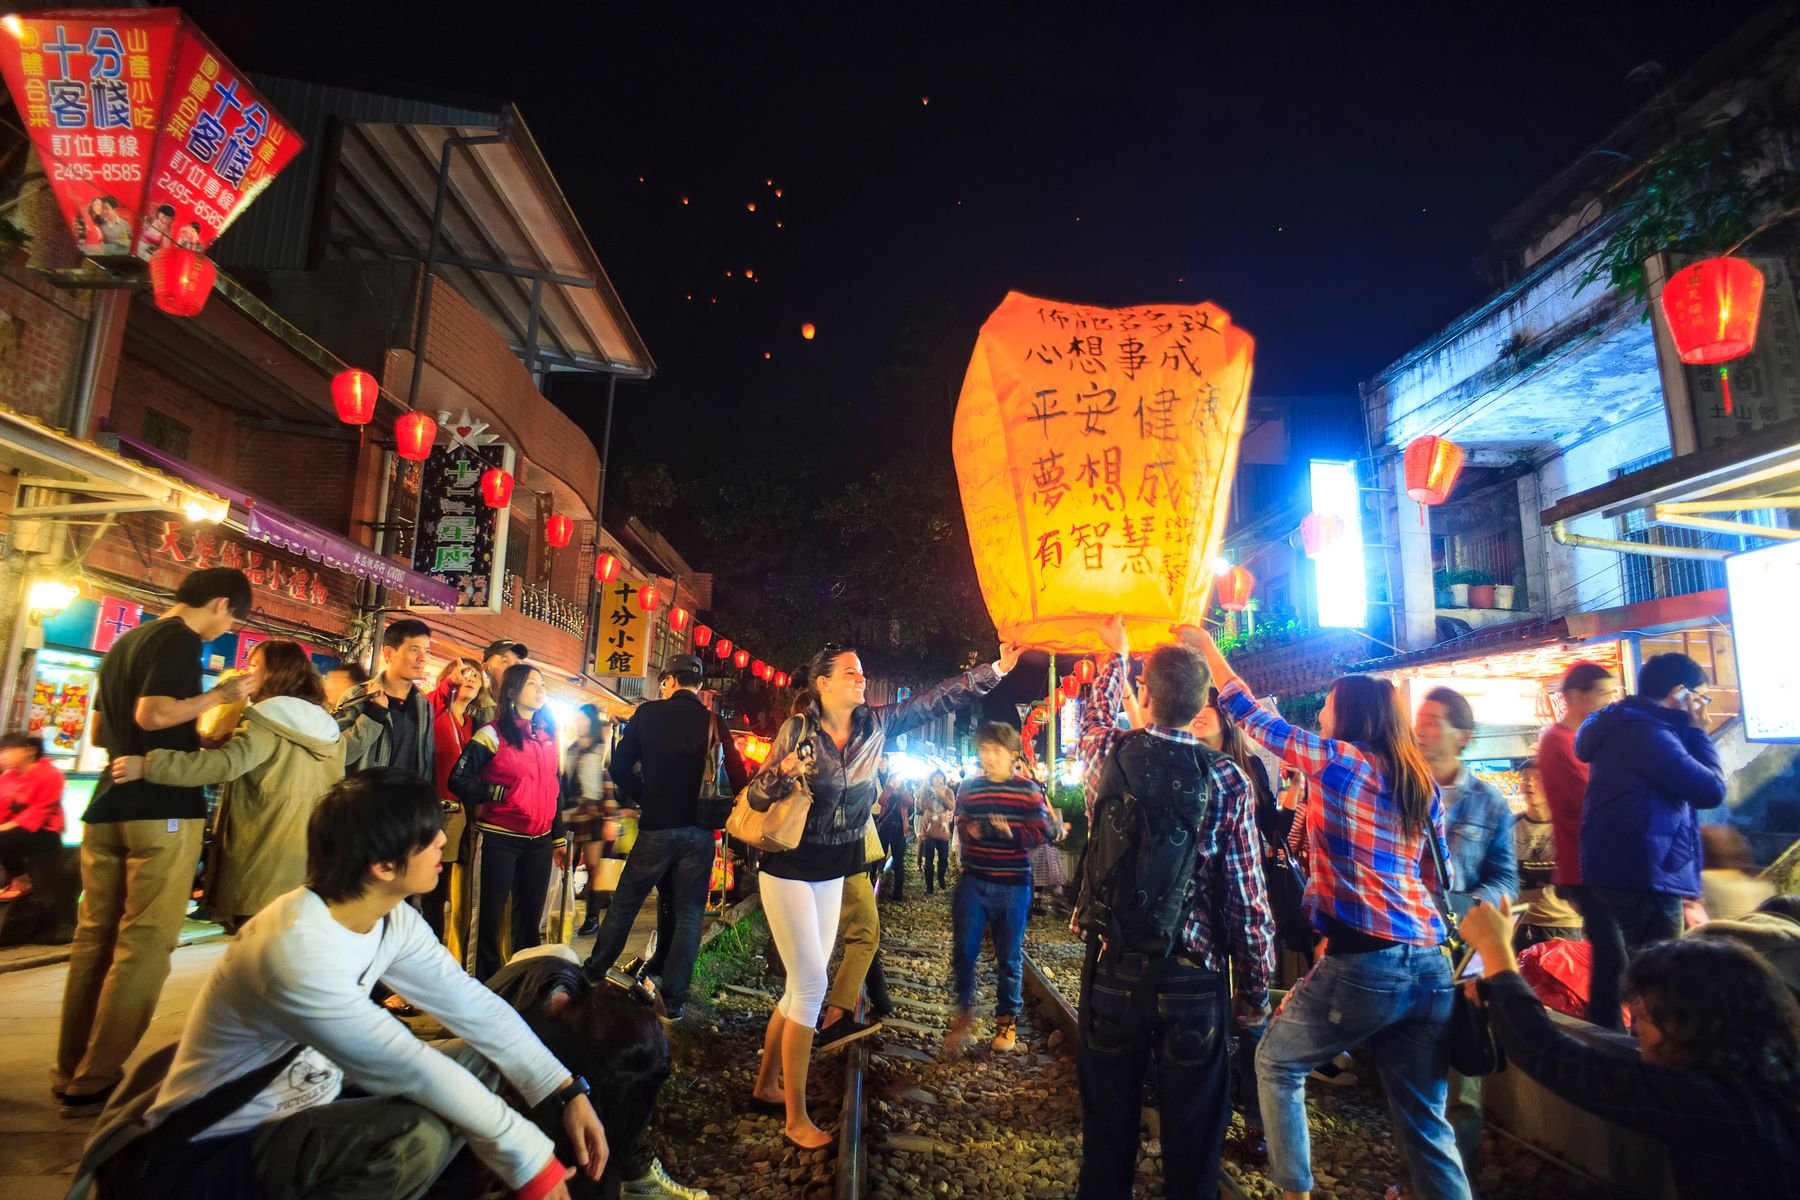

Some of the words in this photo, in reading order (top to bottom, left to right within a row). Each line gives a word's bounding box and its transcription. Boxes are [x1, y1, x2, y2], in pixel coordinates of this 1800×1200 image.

[43, 26, 125, 79] 十分
[127, 28, 155, 129] 山產小吃
[48, 79, 132, 129] 客棧
[166, 53, 219, 141] 團體合菜
[214, 79, 269, 148] 十分
[52, 135, 139, 157] 訂位專線
[54, 163, 141, 181] 2495-8585
[186, 109, 253, 190] 客棧
[157, 172, 225, 229] 2495-8585
[169, 150, 235, 211] 訂位專線
[1025, 334, 1202, 381] 心想事成
[1027, 381, 1223, 442] 平安健康
[606, 583, 638, 673] 十分小館
